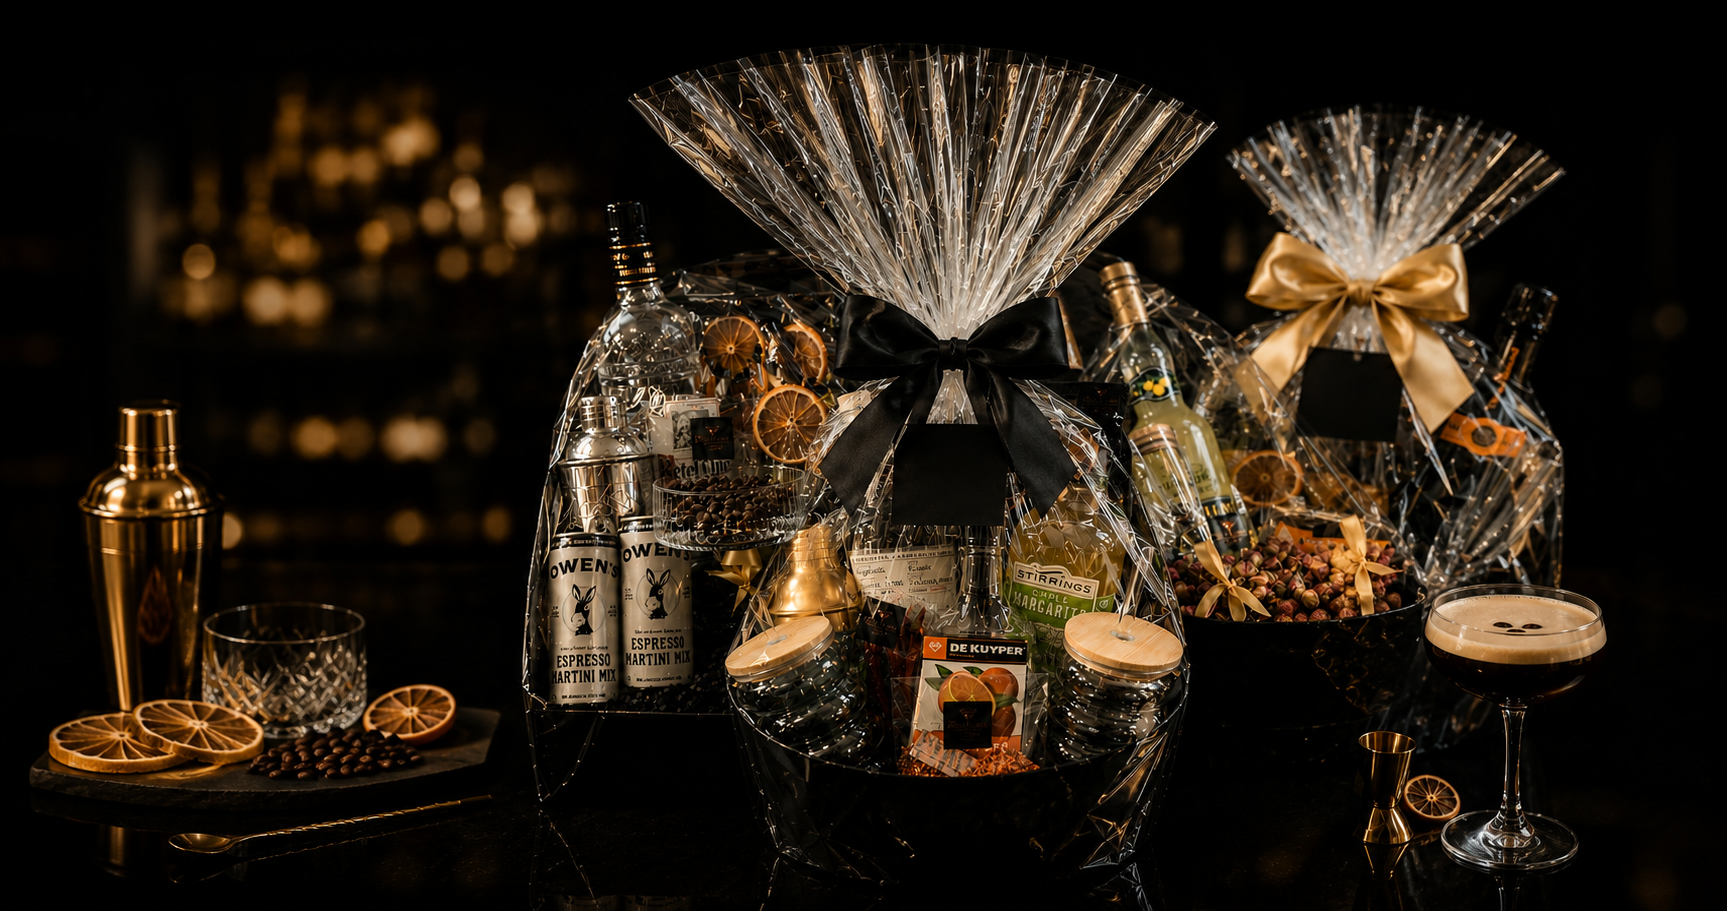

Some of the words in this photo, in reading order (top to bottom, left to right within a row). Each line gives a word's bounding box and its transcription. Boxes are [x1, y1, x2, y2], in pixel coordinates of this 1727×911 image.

[622, 542, 691, 563] OWENS
[550, 557, 619, 580] OWEN'S
[1017, 569, 1092, 595] STIRRINGS
[631, 635, 685, 651] ESPRESSO
[950, 643, 968, 653] DE
[970, 644, 1023, 656] KUYPER
[556, 652, 611, 669] ESPRESSO
[625, 652, 671, 666] MARTINI
[674, 650, 691, 664] MIX
[551, 669, 596, 684] MARTINI
[598, 668, 617, 682] MIX
